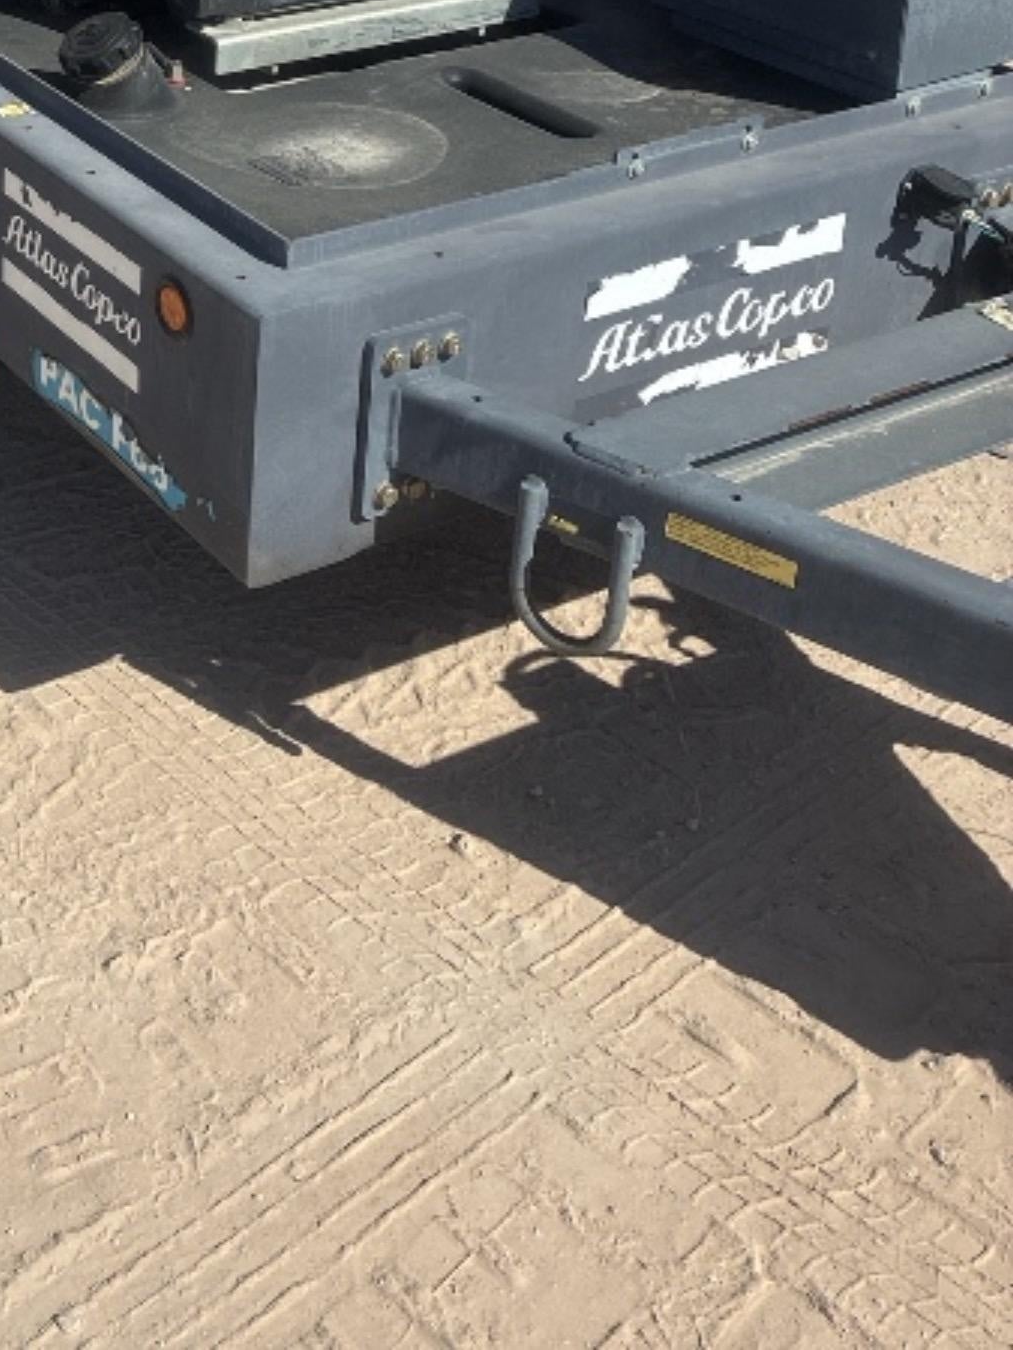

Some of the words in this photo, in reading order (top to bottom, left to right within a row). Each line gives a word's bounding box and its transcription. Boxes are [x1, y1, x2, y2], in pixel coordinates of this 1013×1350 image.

[1, 215, 69, 290] Atlas
[70, 261, 140, 345] Copco
[715, 278, 835, 339] Copco
